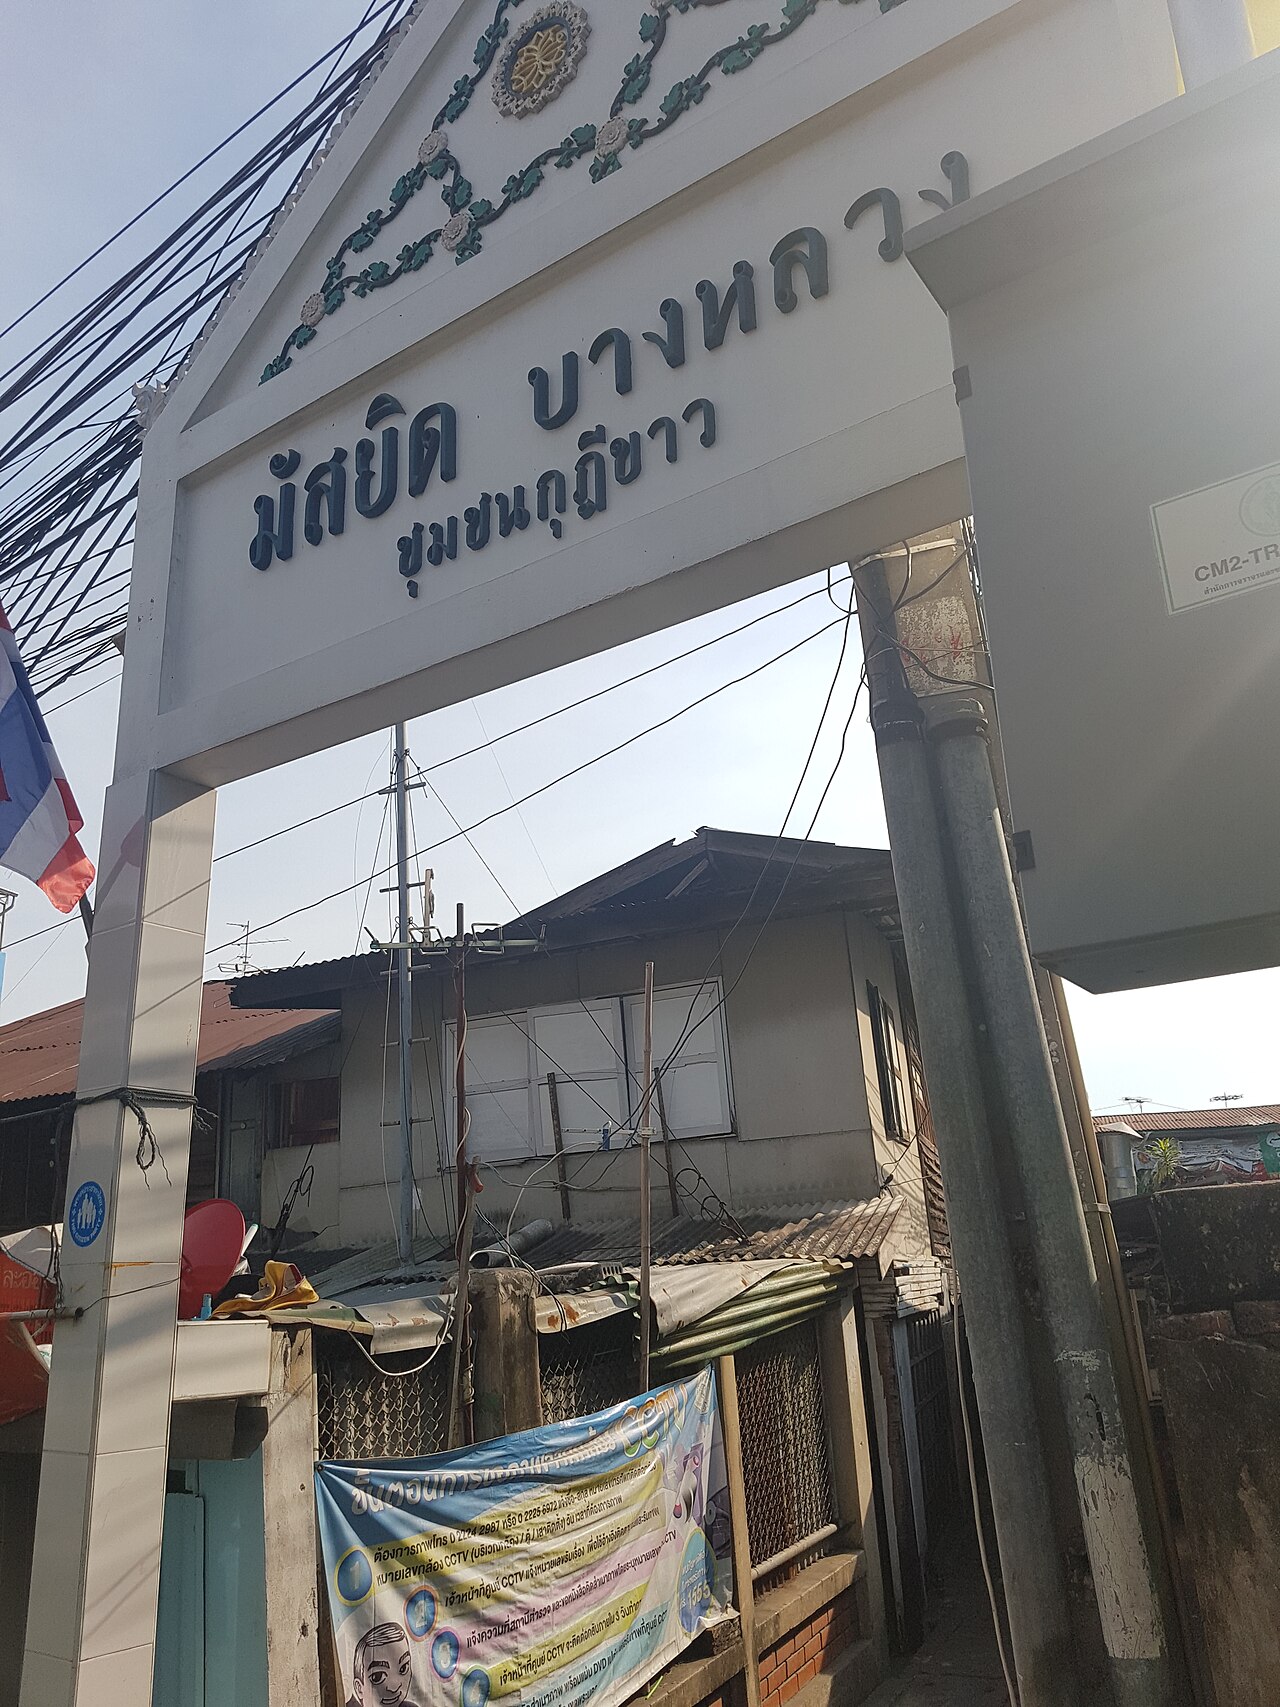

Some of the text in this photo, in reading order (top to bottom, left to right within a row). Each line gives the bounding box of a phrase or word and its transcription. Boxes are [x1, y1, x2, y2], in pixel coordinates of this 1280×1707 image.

[249, 150, 970, 571] มัสยิด บางหลวง
[396, 398, 716, 598] ชุมชนกุฎีขาว
[617, 1383, 688, 1457] CCTV
[478, 1521, 500, 1535] 2987
[502, 1513, 517, 1530] หรือ
[524, 1506, 541, 1522] 2225
[376, 1557, 444, 1587] หมายเลขกล้อง
[444, 1550, 469, 1568] CCTV
[501, 1569, 524, 1588] CCTV
[546, 1644, 566, 1662] CCTV
[593, 1657, 607, 1676] DVD
